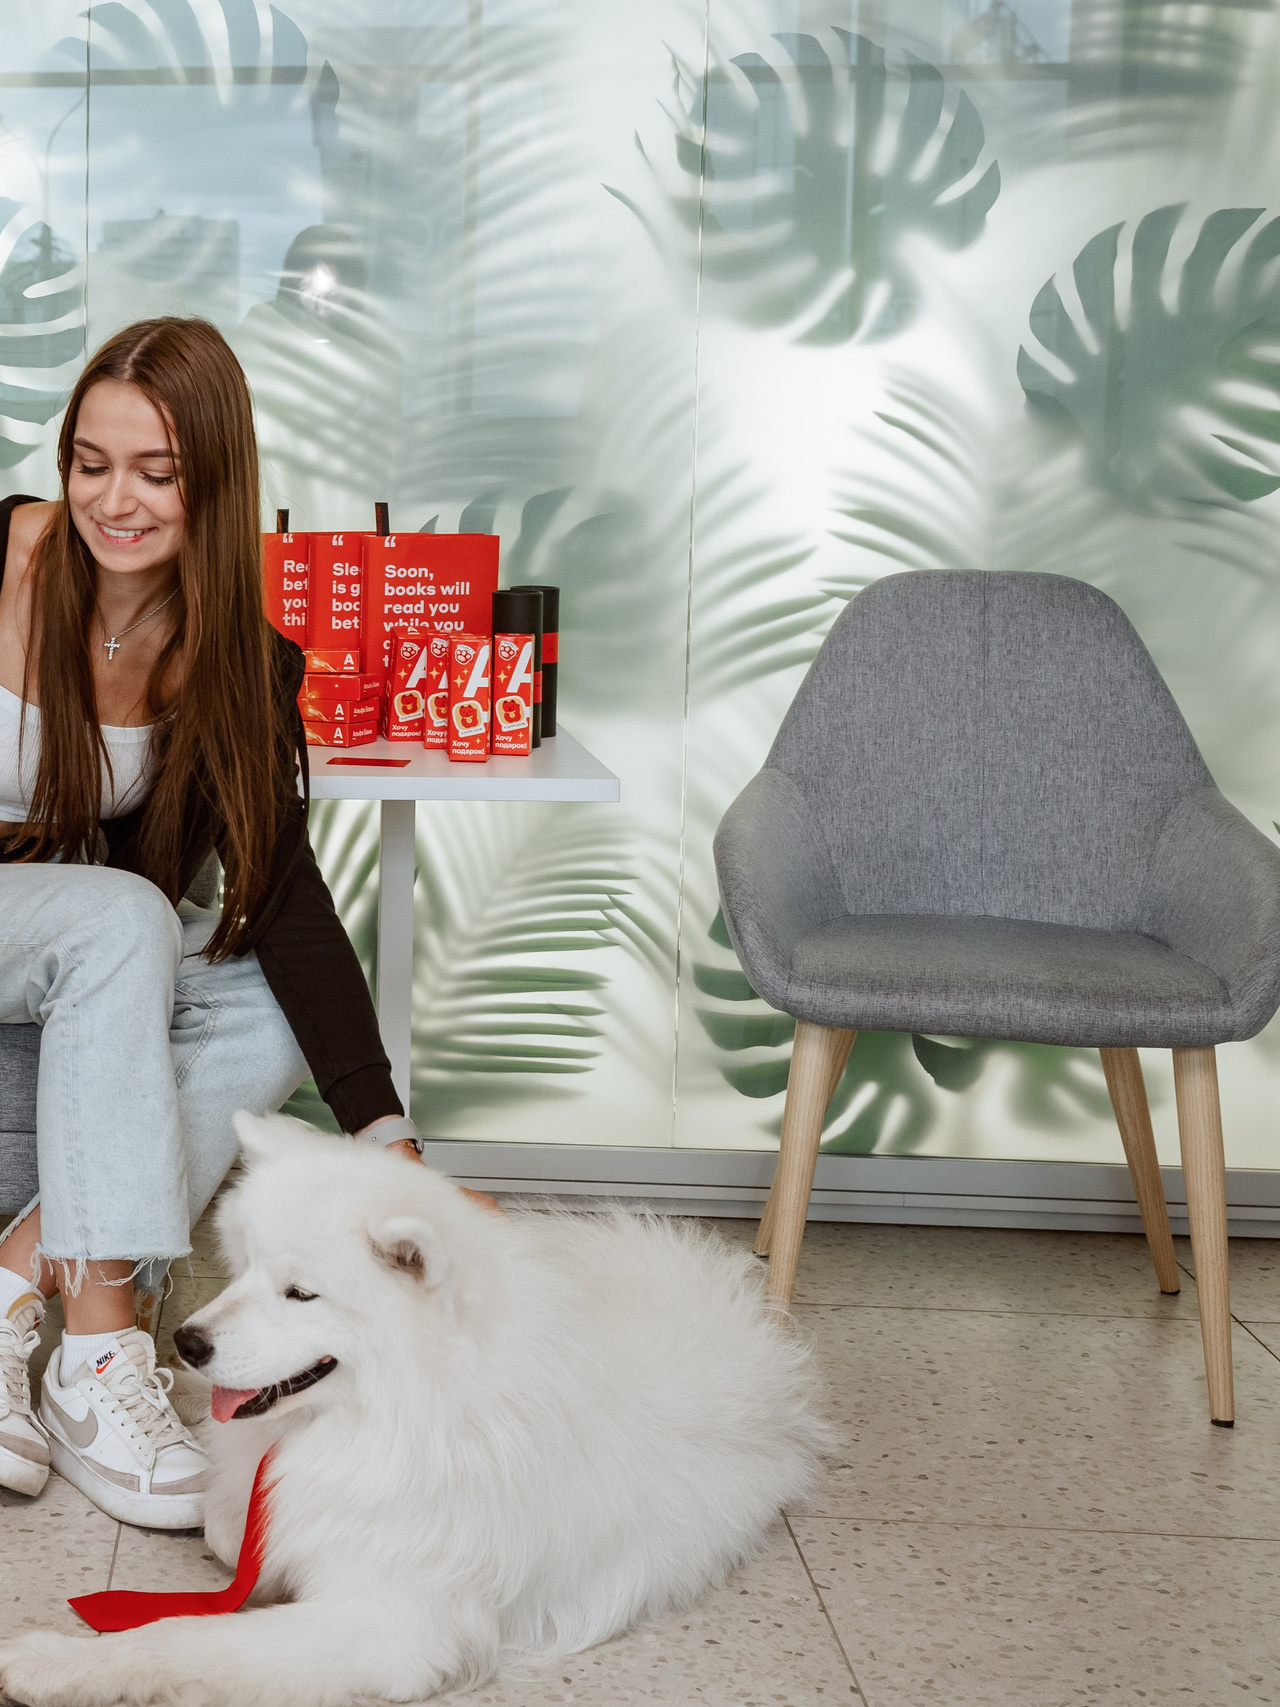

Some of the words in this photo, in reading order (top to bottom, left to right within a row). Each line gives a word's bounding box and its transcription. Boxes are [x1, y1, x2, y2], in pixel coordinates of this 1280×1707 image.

[332, 562, 360, 576] Sle
[384, 564, 434, 580] Soon,
[332, 580, 347, 594] is
[384, 582, 436, 596] books
[440, 581, 470, 595] will
[383, 600, 425, 614] read
[428, 603, 460, 617] you
[452, 740, 470, 748] Хочу
[495, 734, 513, 742] Хочу
[452, 748, 485, 756] подарок!
[495, 742, 527, 750] подарок!
[96, 1351, 115, 1367] NIKE
